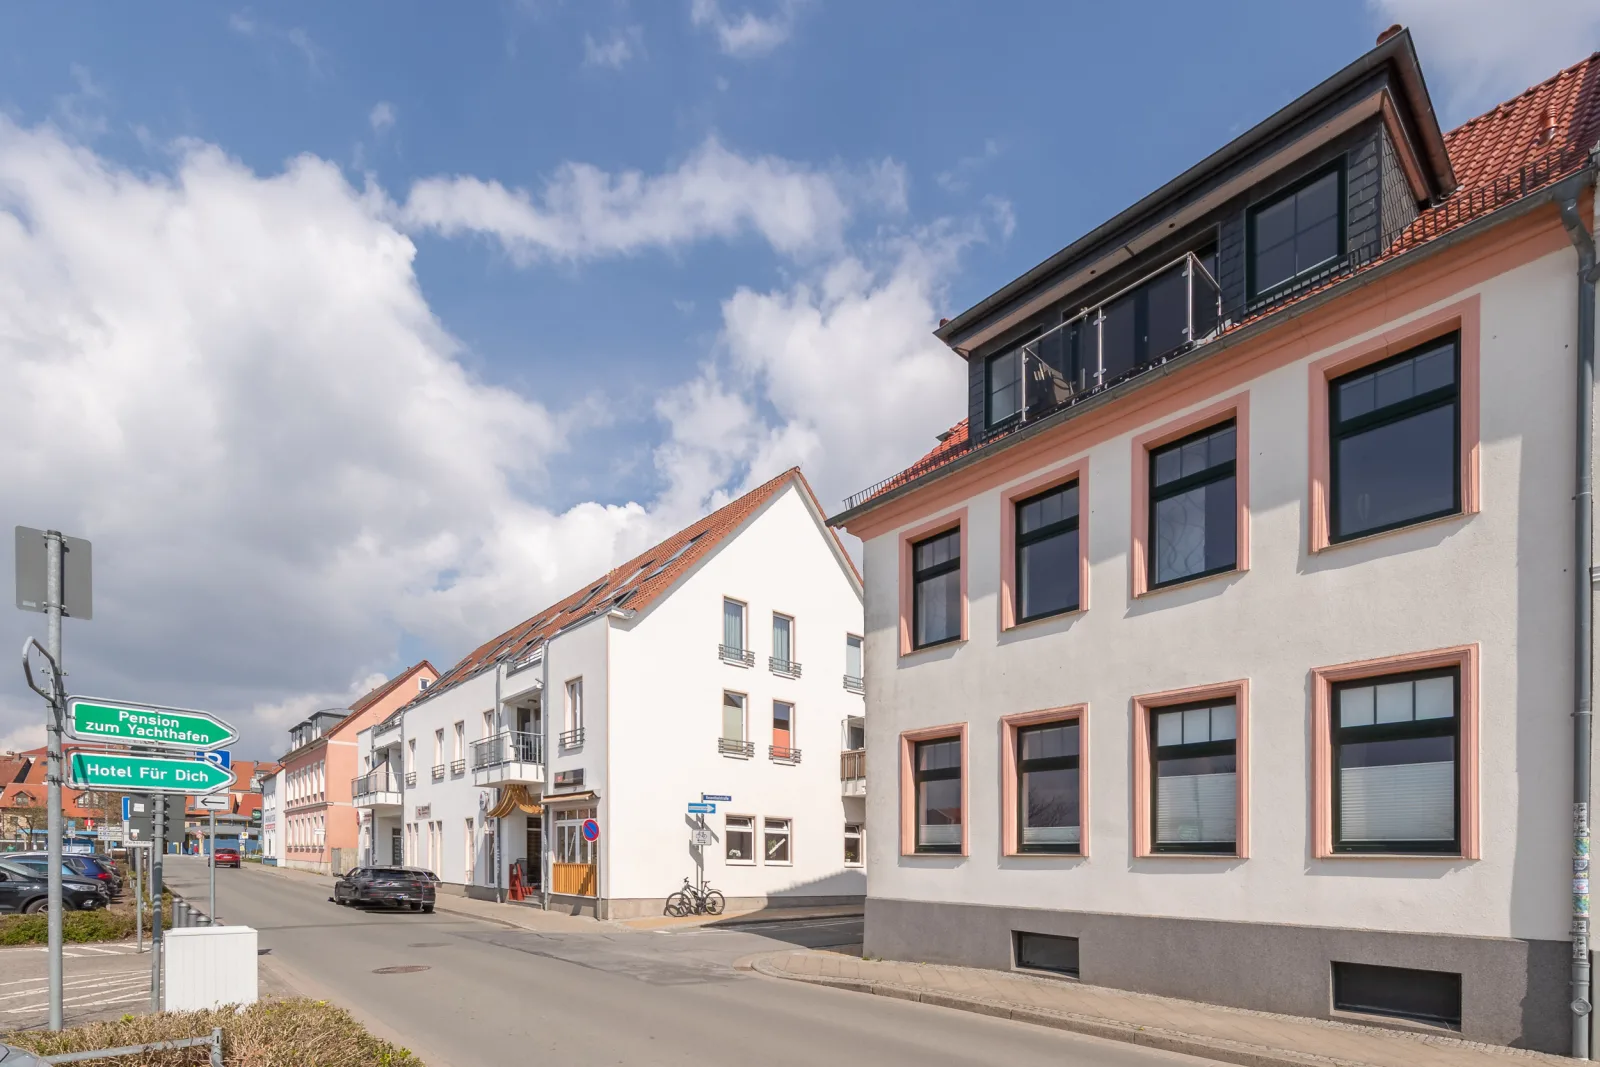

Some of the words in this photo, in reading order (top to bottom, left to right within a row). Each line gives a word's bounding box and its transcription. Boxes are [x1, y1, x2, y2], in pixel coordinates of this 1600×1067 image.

[119, 711, 179, 728] Pension
[86, 721, 120, 733] zum
[127, 724, 209, 742] Yachthafen
[87, 764, 132, 778] Hotel
[140, 767, 167, 780] Für
[175, 769, 208, 782] Dich
